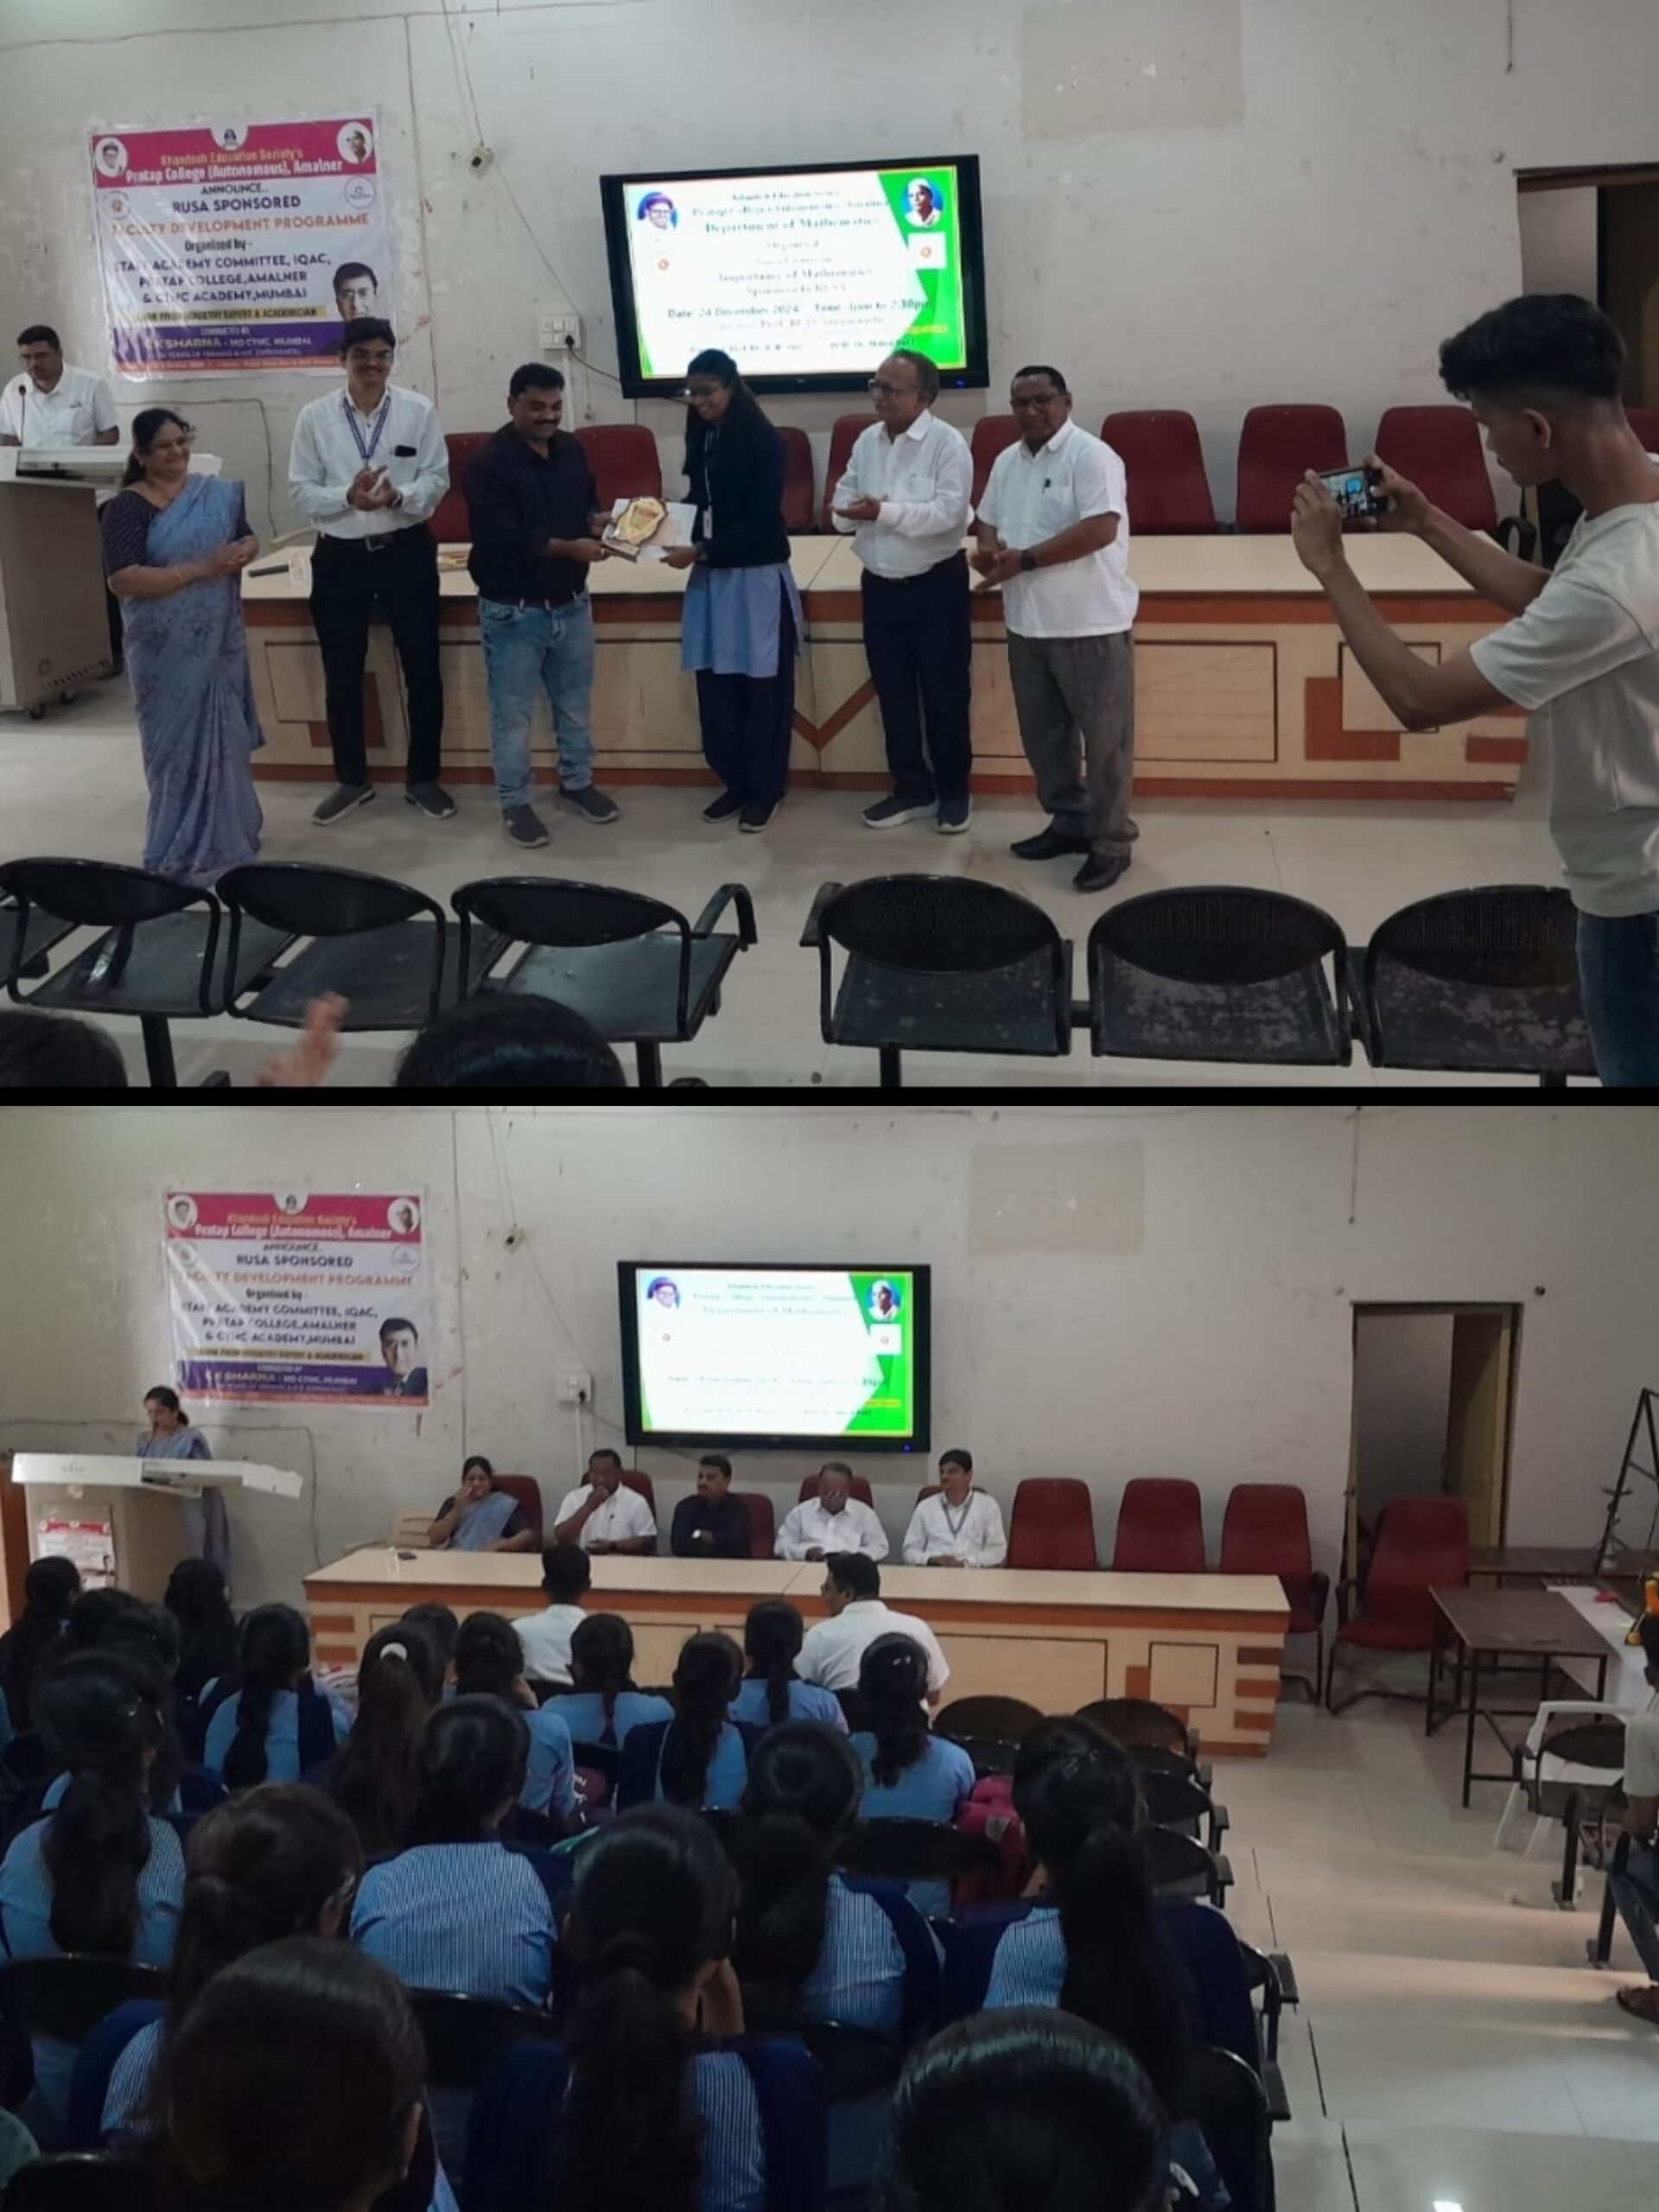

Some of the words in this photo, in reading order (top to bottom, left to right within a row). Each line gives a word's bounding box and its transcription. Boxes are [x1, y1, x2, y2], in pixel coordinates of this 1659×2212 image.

[126, 169, 162, 184] Pratap
[165, 167, 206, 183] College
[173, 200, 209, 214] RUSA
[213, 195, 301, 212] SPONSORED
[274, 213, 369, 230] PROGRAMME
[215, 255, 291, 270] COMMITTEE,
[165, 337, 222, 349] SHARMA
[236, 1255, 270, 1266] RUSA
[274, 1255, 353, 1268] SPONSORED
[233, 1272, 325, 1285] DEVELOPMENT
[327, 1274, 413, 1287] PROGRAMME
